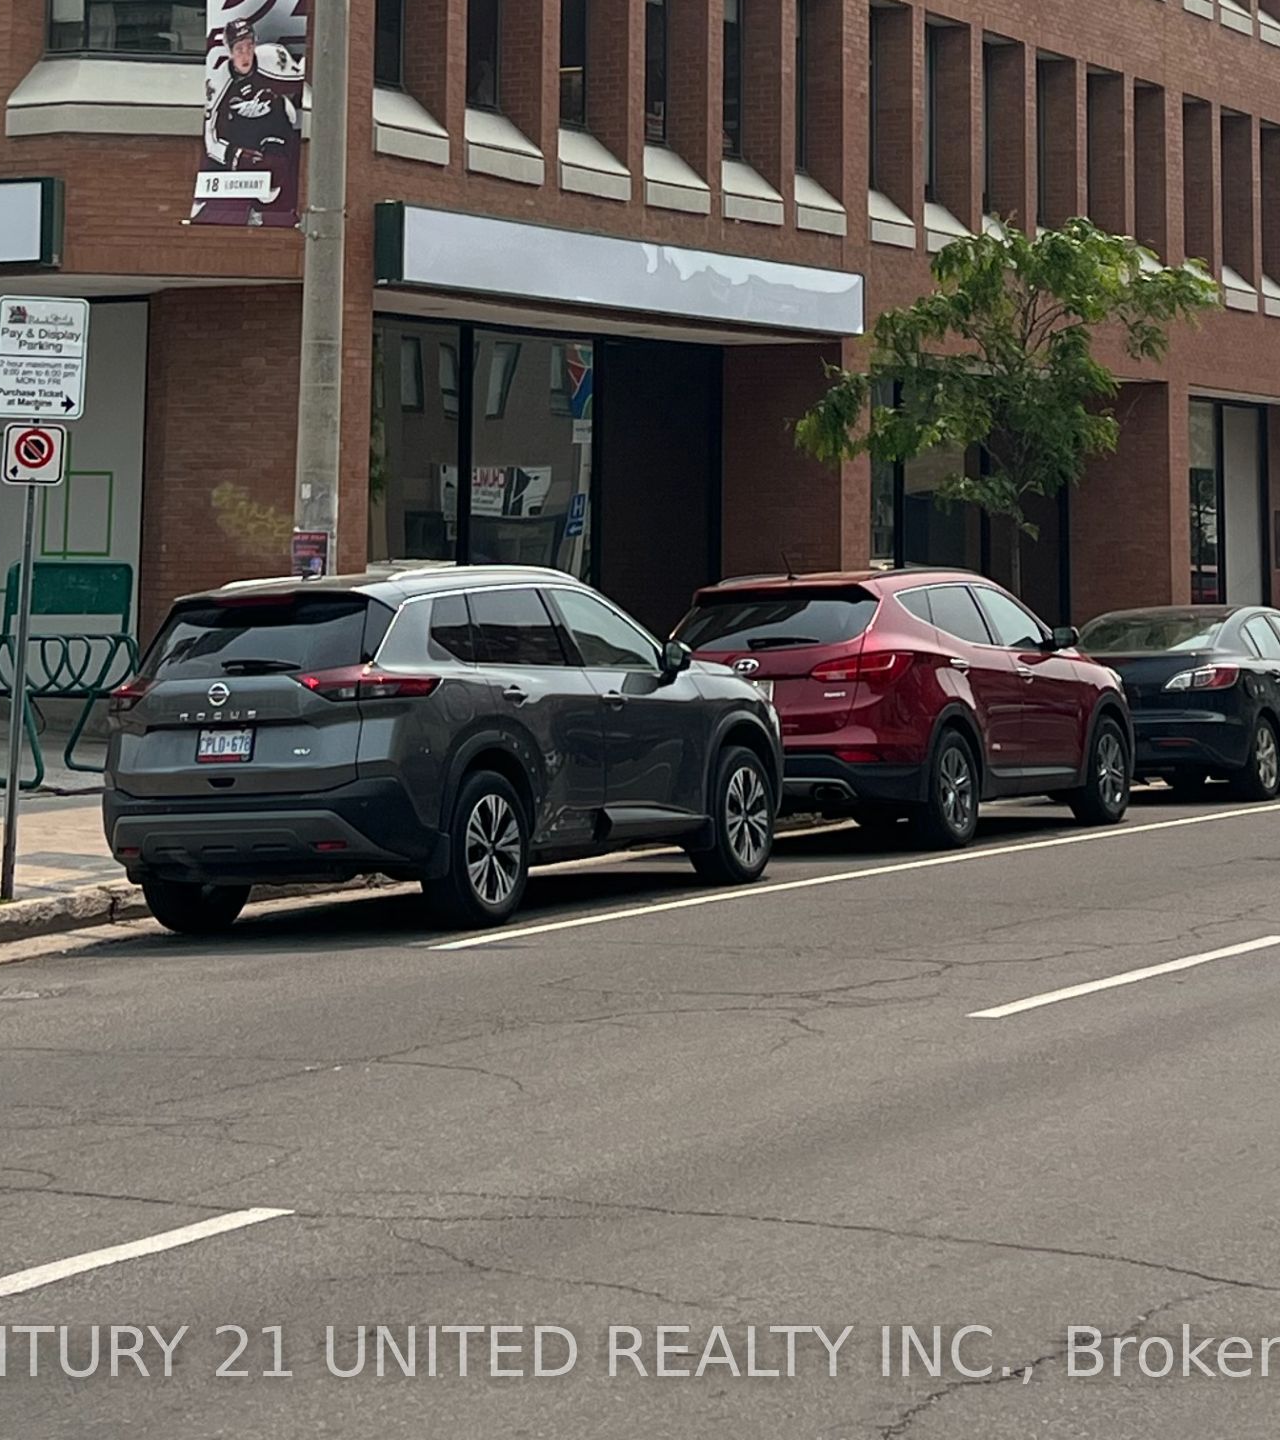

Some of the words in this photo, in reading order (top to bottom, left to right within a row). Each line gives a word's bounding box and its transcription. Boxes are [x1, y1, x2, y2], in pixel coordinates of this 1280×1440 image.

[206, 177, 219, 192] 18
[1, 327, 22, 340] Pay
[26, 328, 35, 338] &
[38, 328, 81, 342] Display
[18, 340, 63, 353] Parking
